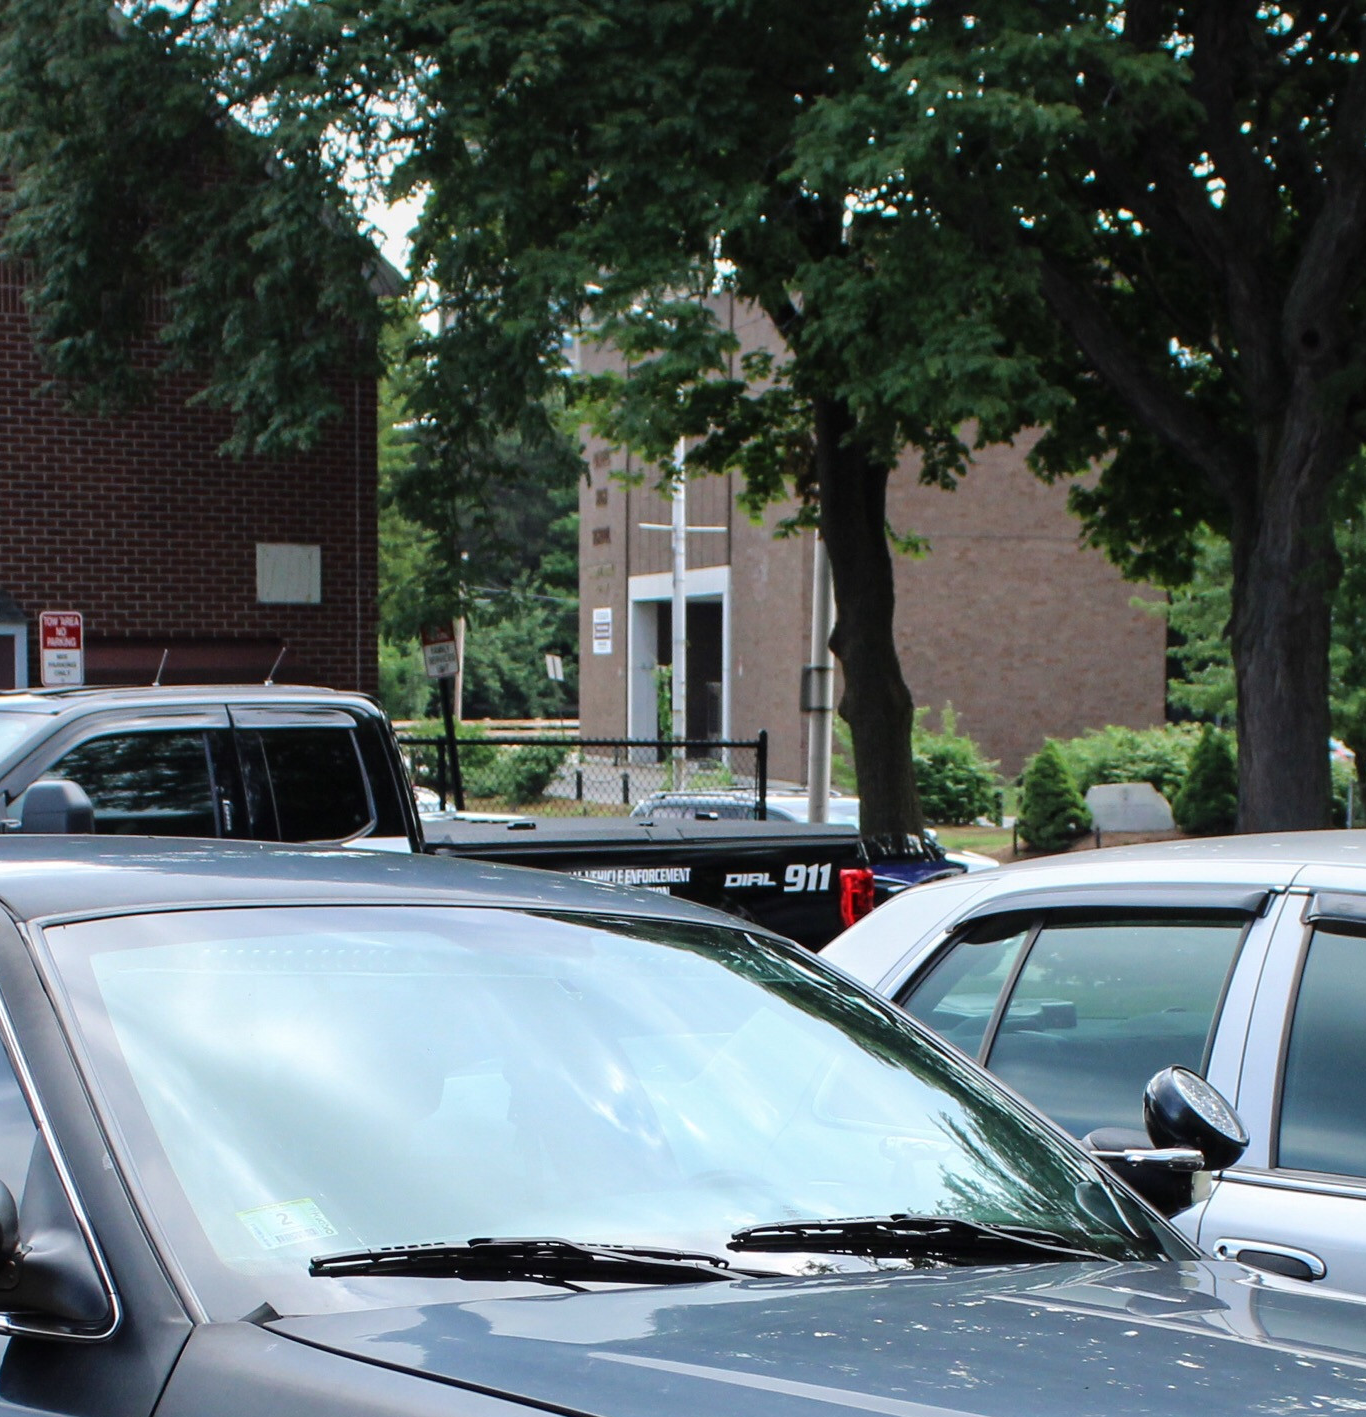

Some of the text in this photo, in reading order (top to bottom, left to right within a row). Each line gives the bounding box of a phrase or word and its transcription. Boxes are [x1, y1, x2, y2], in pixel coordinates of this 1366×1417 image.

[43, 616, 79, 626] TOW AREA
[55, 627, 67, 636] NO
[47, 637, 77, 647] PARKING
[624, 867, 691, 884] ENFORCEMENT
[724, 863, 832, 892] DIAL 911
